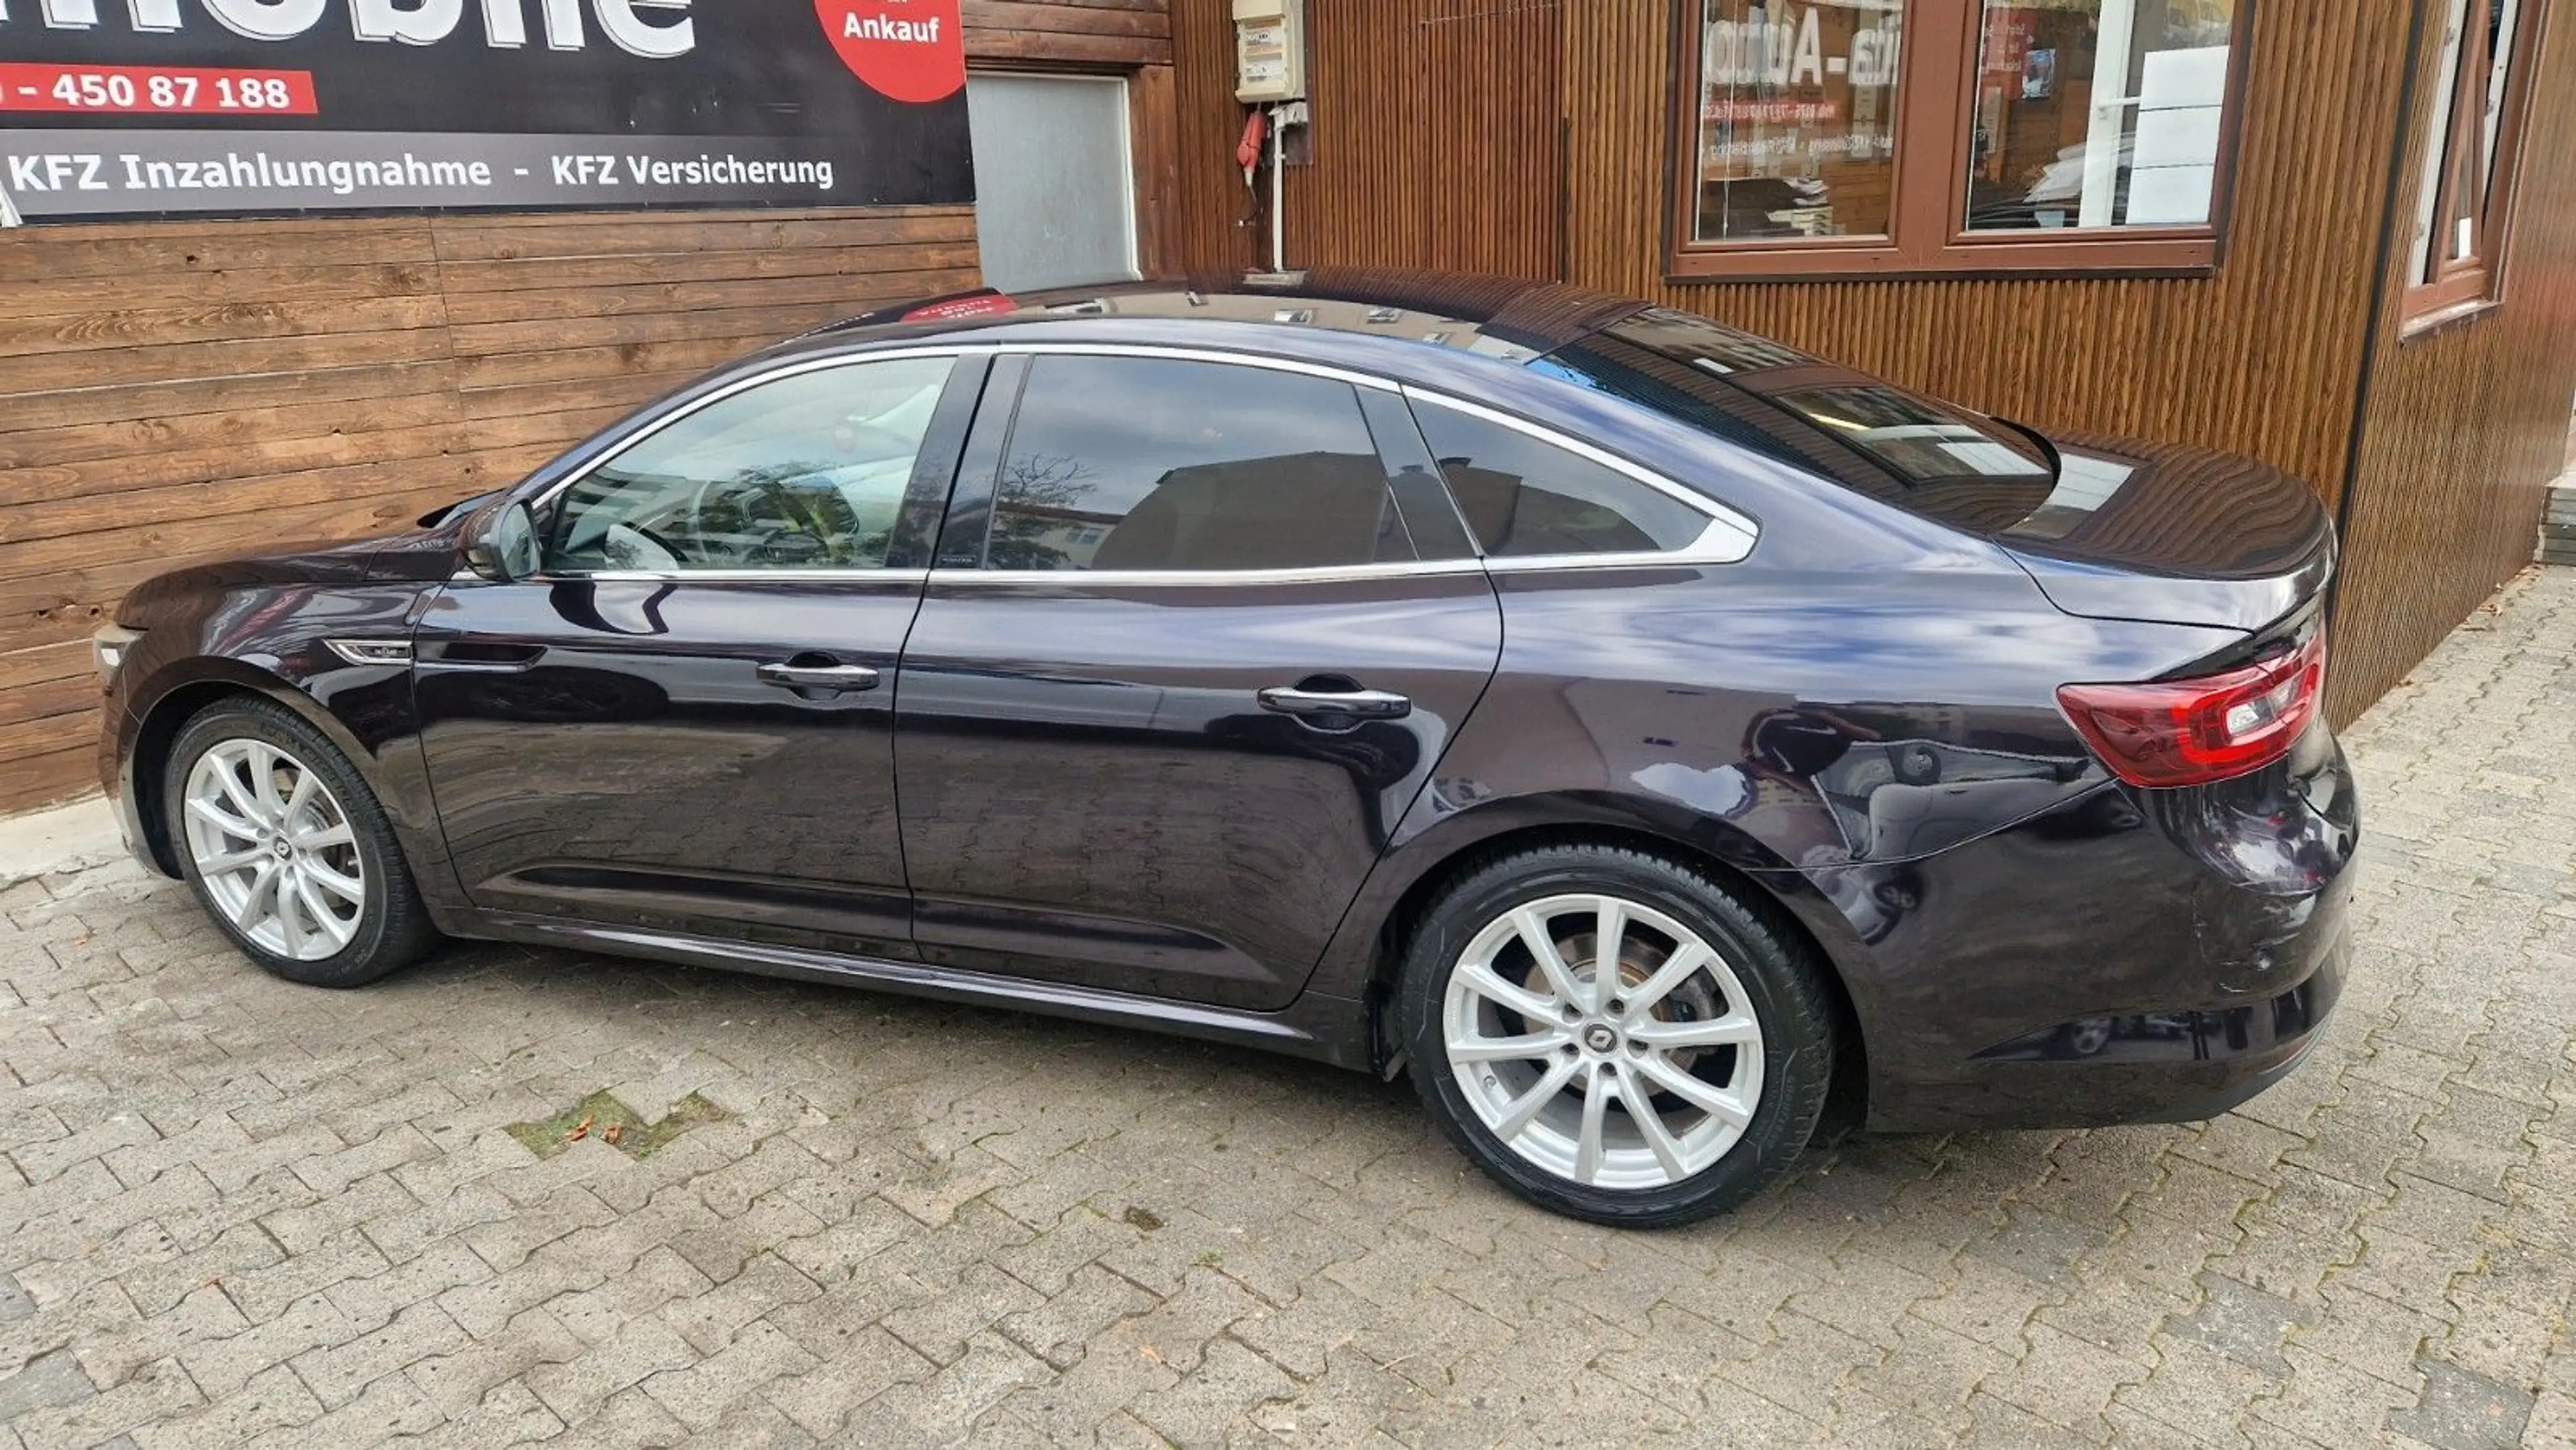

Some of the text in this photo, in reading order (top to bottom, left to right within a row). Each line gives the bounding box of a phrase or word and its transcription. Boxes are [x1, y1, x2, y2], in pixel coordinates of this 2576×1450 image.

[843, 12, 940, 43] Ankauf
[52, 74, 136, 107] 450
[148, 75, 199, 108] 87
[215, 77, 290, 109] 188
[7, 154, 109, 191] KFZ
[118, 152, 492, 194] Inzahlungnahme
[551, 155, 620, 186] KFZ
[625, 154, 834, 190] Versicherung
